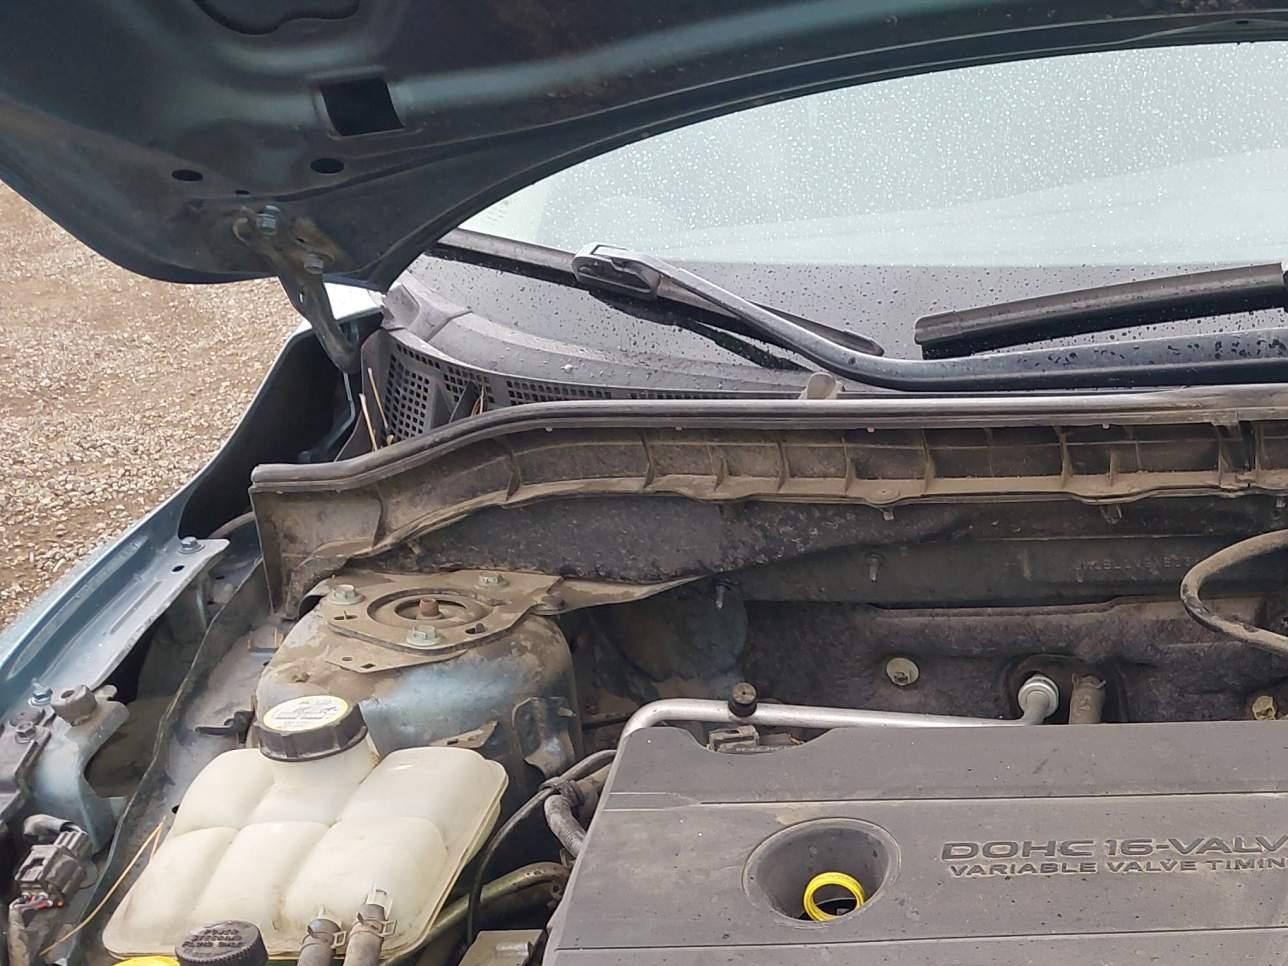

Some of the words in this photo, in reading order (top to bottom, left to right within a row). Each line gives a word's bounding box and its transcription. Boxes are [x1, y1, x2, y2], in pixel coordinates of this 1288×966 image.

[941, 839, 1097, 861] DOHC
[950, 862, 1098, 877] VARIABLE
[1106, 859, 1198, 873] VALVE
